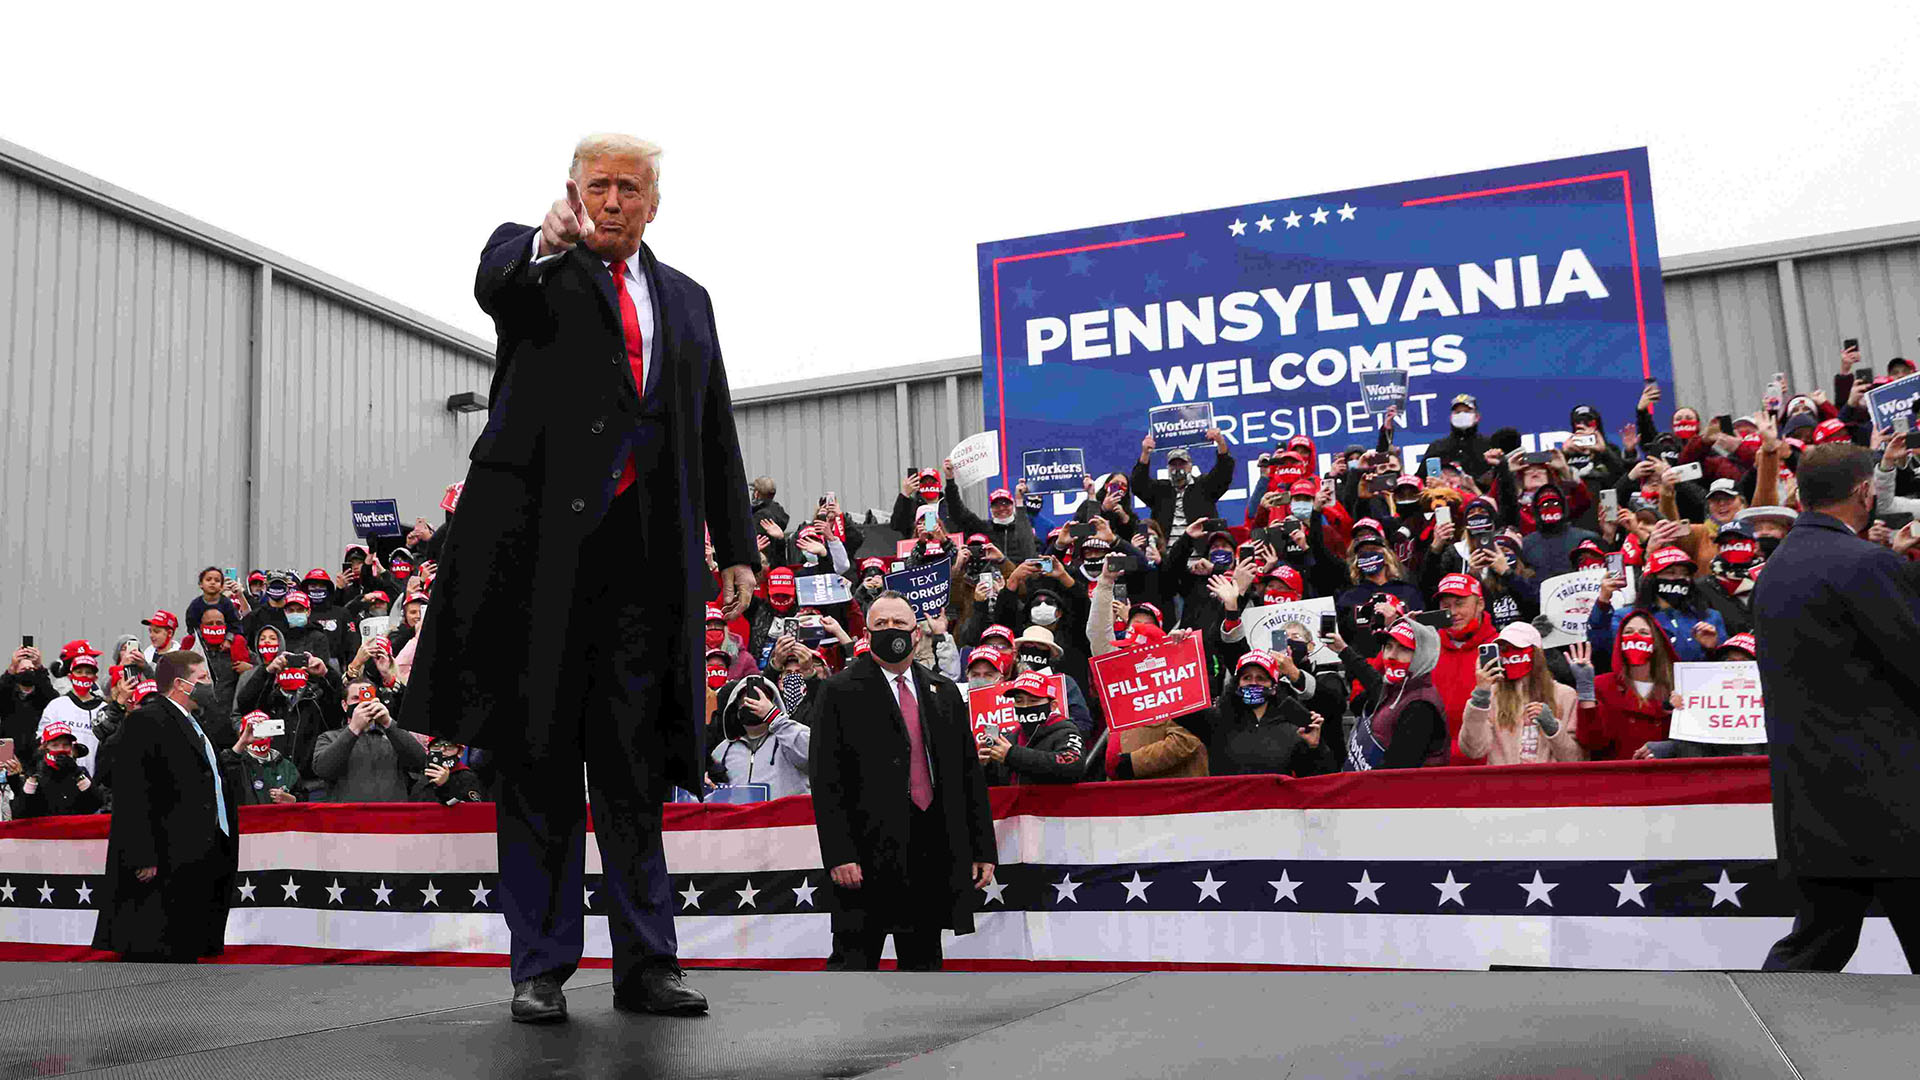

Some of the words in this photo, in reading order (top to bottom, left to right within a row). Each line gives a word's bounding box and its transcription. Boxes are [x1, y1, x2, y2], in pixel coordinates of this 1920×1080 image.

[1026, 248, 1609, 366] PENNSYLVANIA
[1149, 334, 1467, 403] WELCOMES
[1154, 419, 1208, 433] Workers
[1213, 393, 1437, 447] RESIDENT
[1026, 462, 1082, 476] Workers
[353, 511, 395, 523] Workers
[910, 572, 938, 587] TEXT
[1557, 583, 1600, 601] TRUCKER
[1658, 584, 1688, 595] MAG
[911, 604, 920, 614] O
[1562, 620, 1578, 630] FOR
[1503, 653, 1532, 665] AGA
[1107, 677, 1149, 698] FILL
[1151, 663, 1197, 687] THAT
[1132, 686, 1184, 712] SEAT!
[1688, 696, 1729, 709] FILL
[1737, 695, 1764, 709] TH
[1018, 711, 1047, 723] AGA
[1708, 714, 1761, 728] SEAT
[61, 720, 92, 730] TRUM
